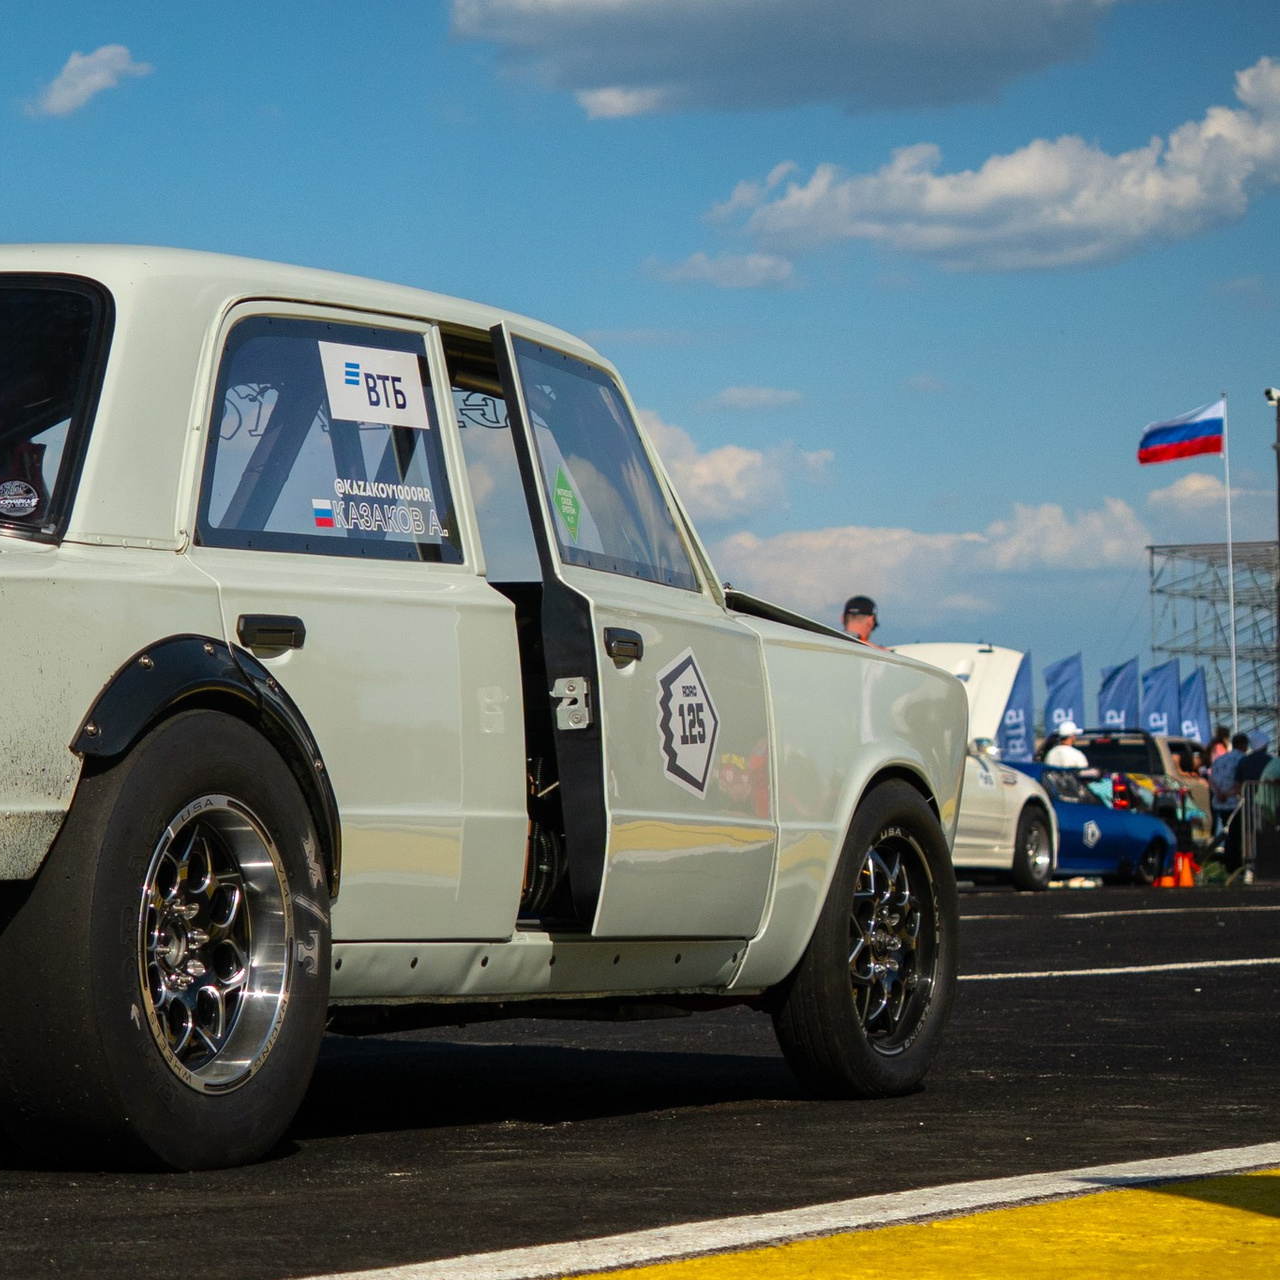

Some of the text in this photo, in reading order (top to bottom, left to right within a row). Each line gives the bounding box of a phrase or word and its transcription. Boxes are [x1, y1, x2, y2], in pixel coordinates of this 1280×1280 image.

[363, 372, 407, 410] ВТБ
[334, 478, 432, 503] @KAZAKOV1000RR
[332, 500, 425, 535] КАЗАКОВ
[678, 703, 706, 745] 125
[181, 798, 213, 823] USA
[880, 827, 902, 840] USA
[149, 1010, 193, 1084] WHEELS
